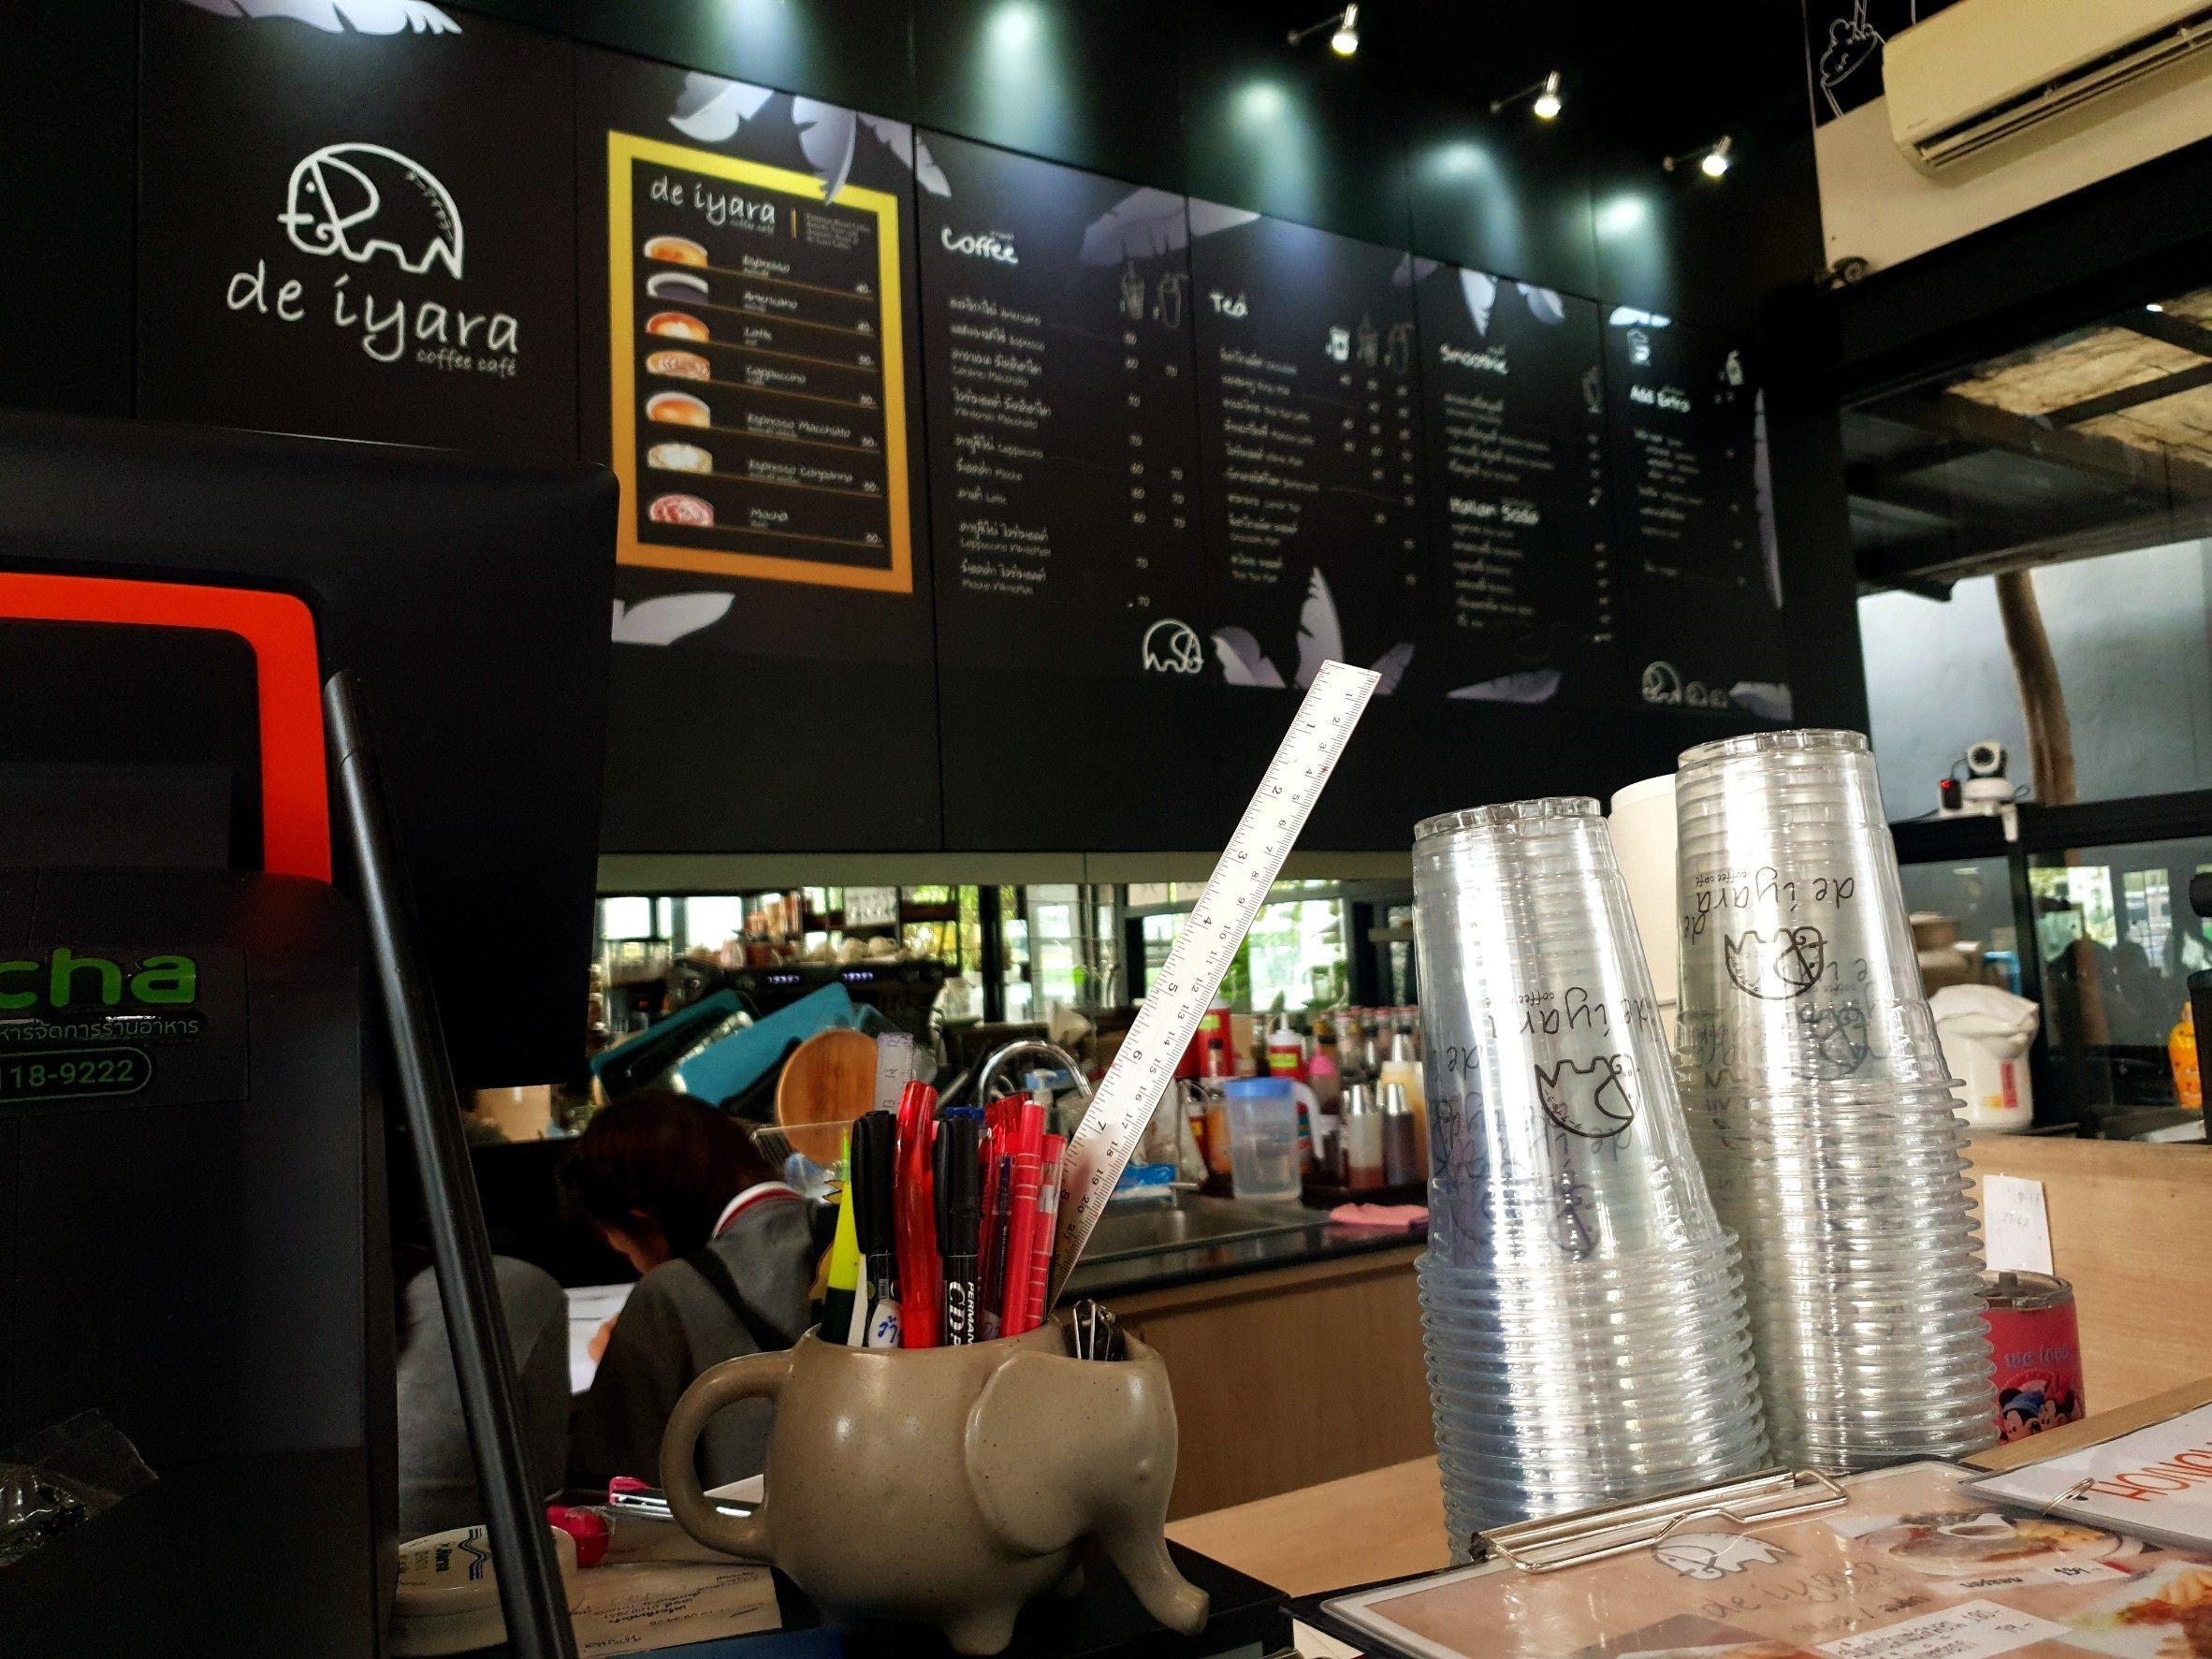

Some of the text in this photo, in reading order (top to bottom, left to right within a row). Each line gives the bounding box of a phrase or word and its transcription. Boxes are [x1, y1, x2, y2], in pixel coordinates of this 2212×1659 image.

[648, 175, 776, 225] de iyara
[940, 226, 1019, 266] Coffee
[226, 258, 520, 363] de iyara
[415, 347, 472, 372] coffee
[1273, 786, 1283, 795] 2
[1238, 851, 1248, 861] 3
[1695, 866, 1855, 915] de iyara
[1203, 916, 1213, 924] 4
[1168, 982, 1179, 993] 5
[1132, 1051, 1142, 1061] 6
[0, 1059, 135, 1089] 18-9222
[1098, 1120, 1107, 1131] 7
[949, 1281, 966, 1332] CD
